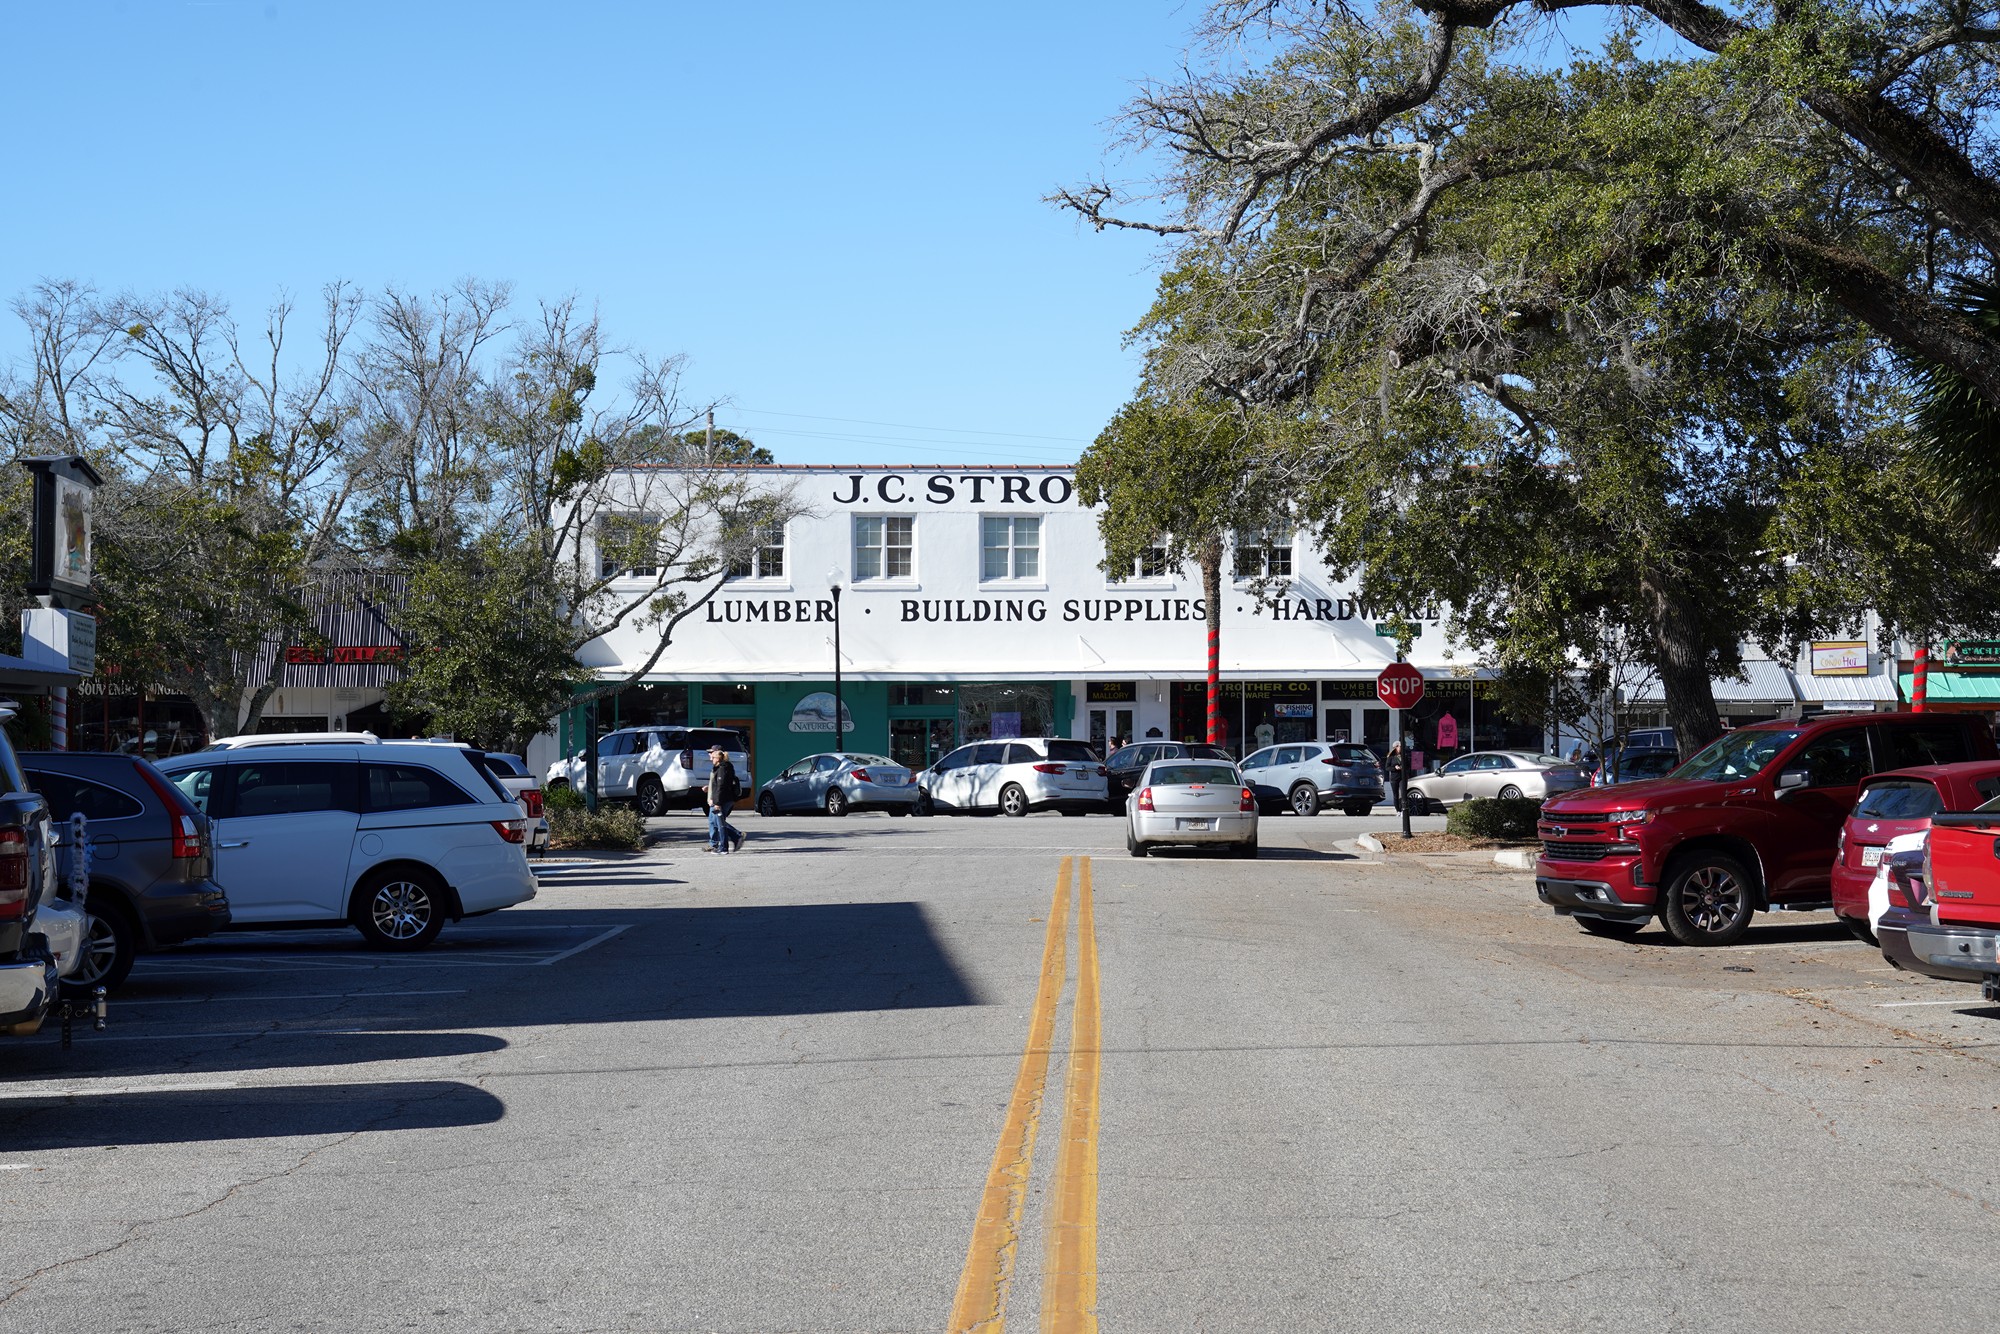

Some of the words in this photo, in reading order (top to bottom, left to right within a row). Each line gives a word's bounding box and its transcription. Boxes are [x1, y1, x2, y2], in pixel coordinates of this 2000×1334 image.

[926, 475, 1074, 505] STRO
[706, 600, 836, 623] LUMBER
[901, 600, 1047, 622] BUILDING
[1063, 599, 1208, 622] SUPPLIES
[334, 648, 402, 661] VILLAE
[1103, 683, 1121, 691] 221
[1218, 682, 1283, 691] TROTHER
[1288, 682, 1311, 691] CO.
[1333, 682, 1374, 691] LUMBE
[1381, 677, 1421, 695] STOP
[1092, 691, 1129, 700] MALLORY
[1343, 690, 1374, 698] YARD
